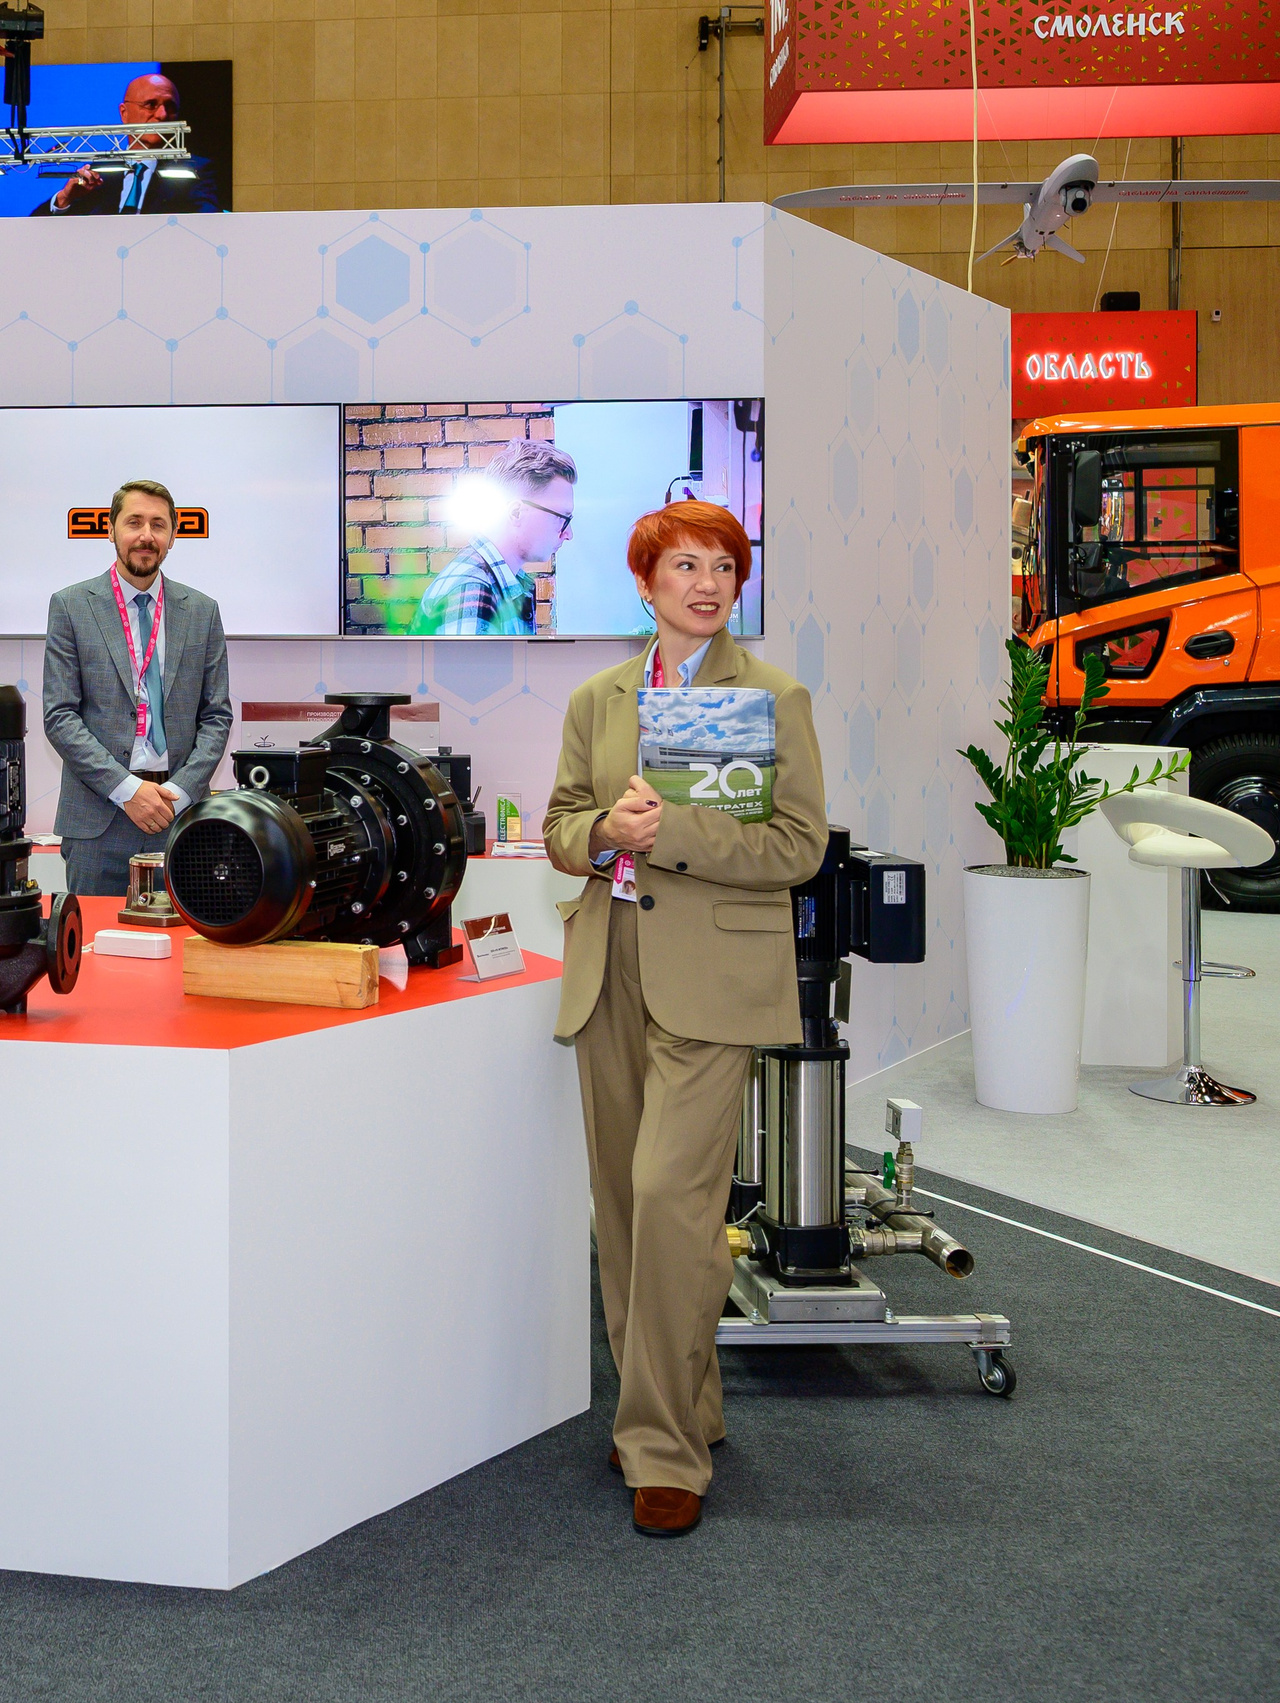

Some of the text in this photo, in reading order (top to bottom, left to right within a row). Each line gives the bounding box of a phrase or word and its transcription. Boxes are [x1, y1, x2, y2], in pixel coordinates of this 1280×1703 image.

[1034, 12, 1185, 39] СМОЛЕНСК
[1026, 353, 1152, 380] ОБЛАСТЬ
[737, 788, 762, 798] лет
